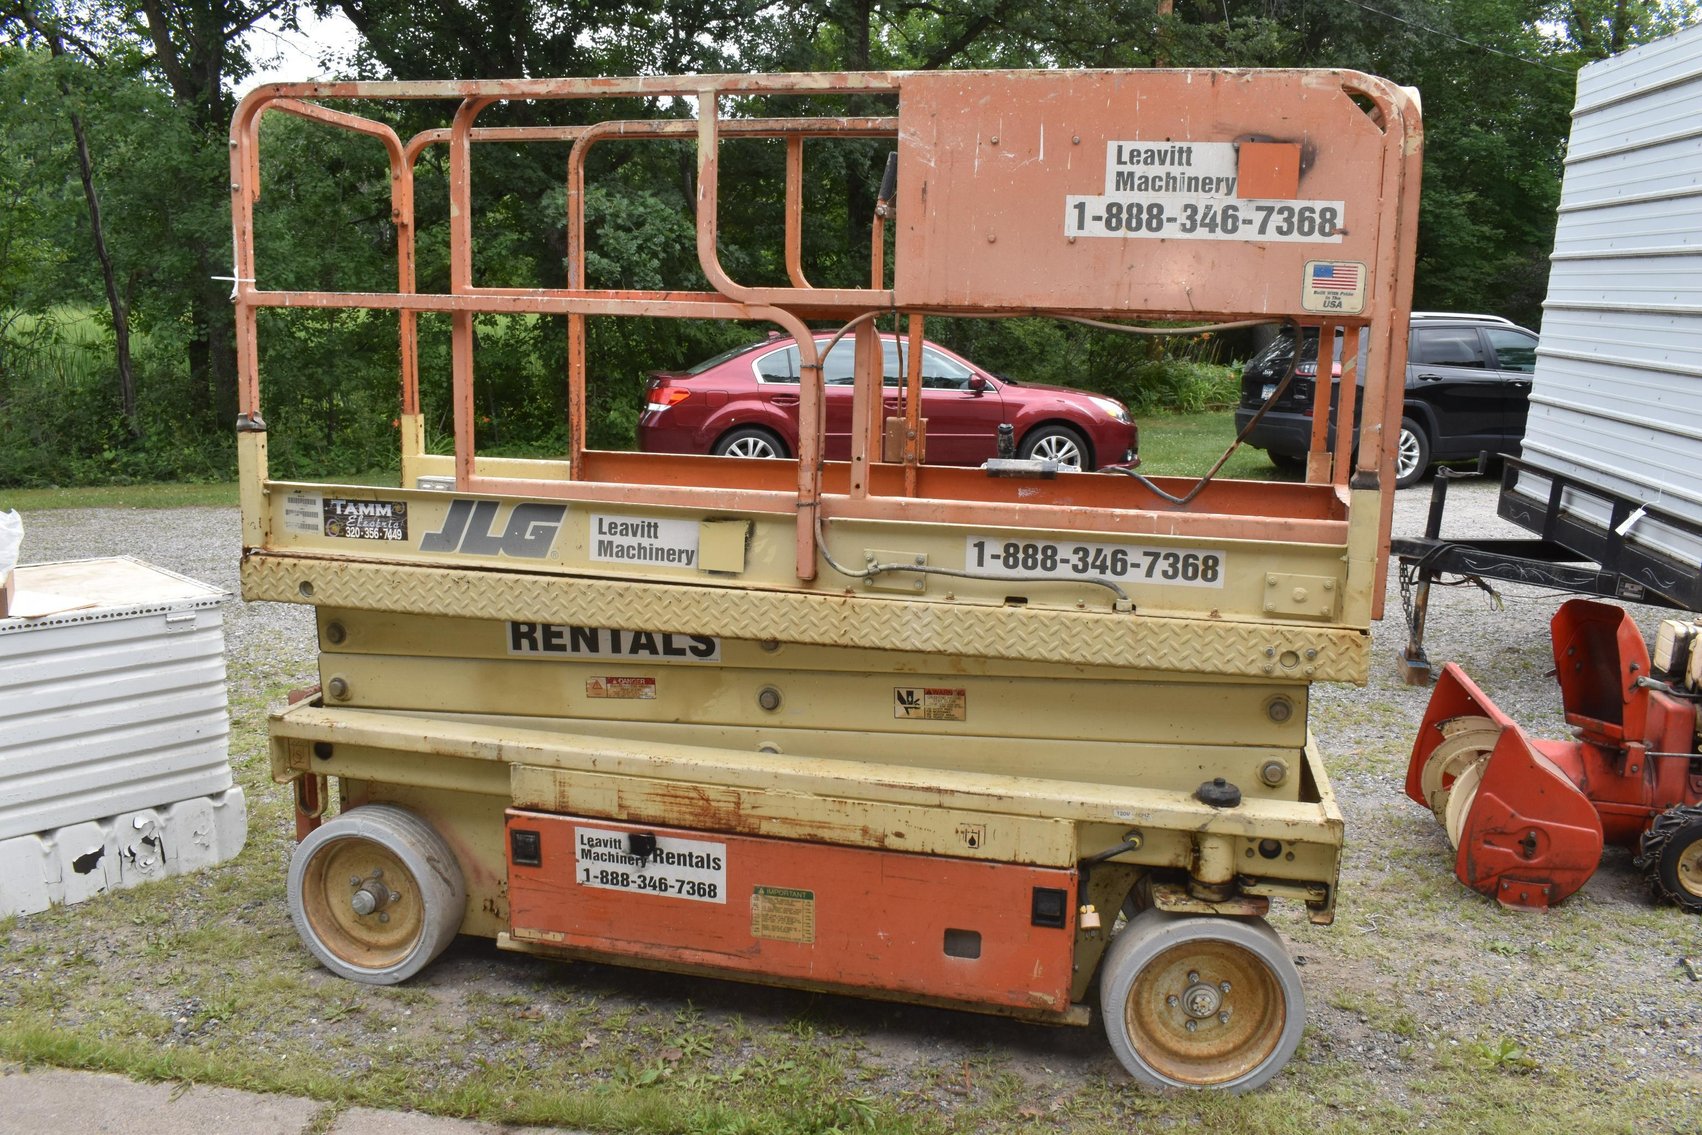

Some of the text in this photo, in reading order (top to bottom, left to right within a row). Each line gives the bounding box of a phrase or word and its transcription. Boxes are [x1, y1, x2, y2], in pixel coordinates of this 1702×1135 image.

[1116, 144, 1193, 167] Leavitt
[1114, 171, 1237, 197] Machinery
[1073, 201, 1338, 238] 1-888-346-7368
[1323, 300, 1343, 309] USA
[330, 500, 393, 517] TAMM
[418, 499, 568, 559] JLG
[598, 517, 659, 540] Leavitt
[597, 539, 696, 566] Machinery
[973, 540, 1220, 583] 1-888-346-7368
[511, 621, 716, 658] RENTALS
[580, 834, 622, 850] Leavitt
[580, 847, 722, 871] Machinery Rentals
[583, 867, 718, 899] 1-888-346-7368
[766, 888, 806, 898] IMPORTANT
